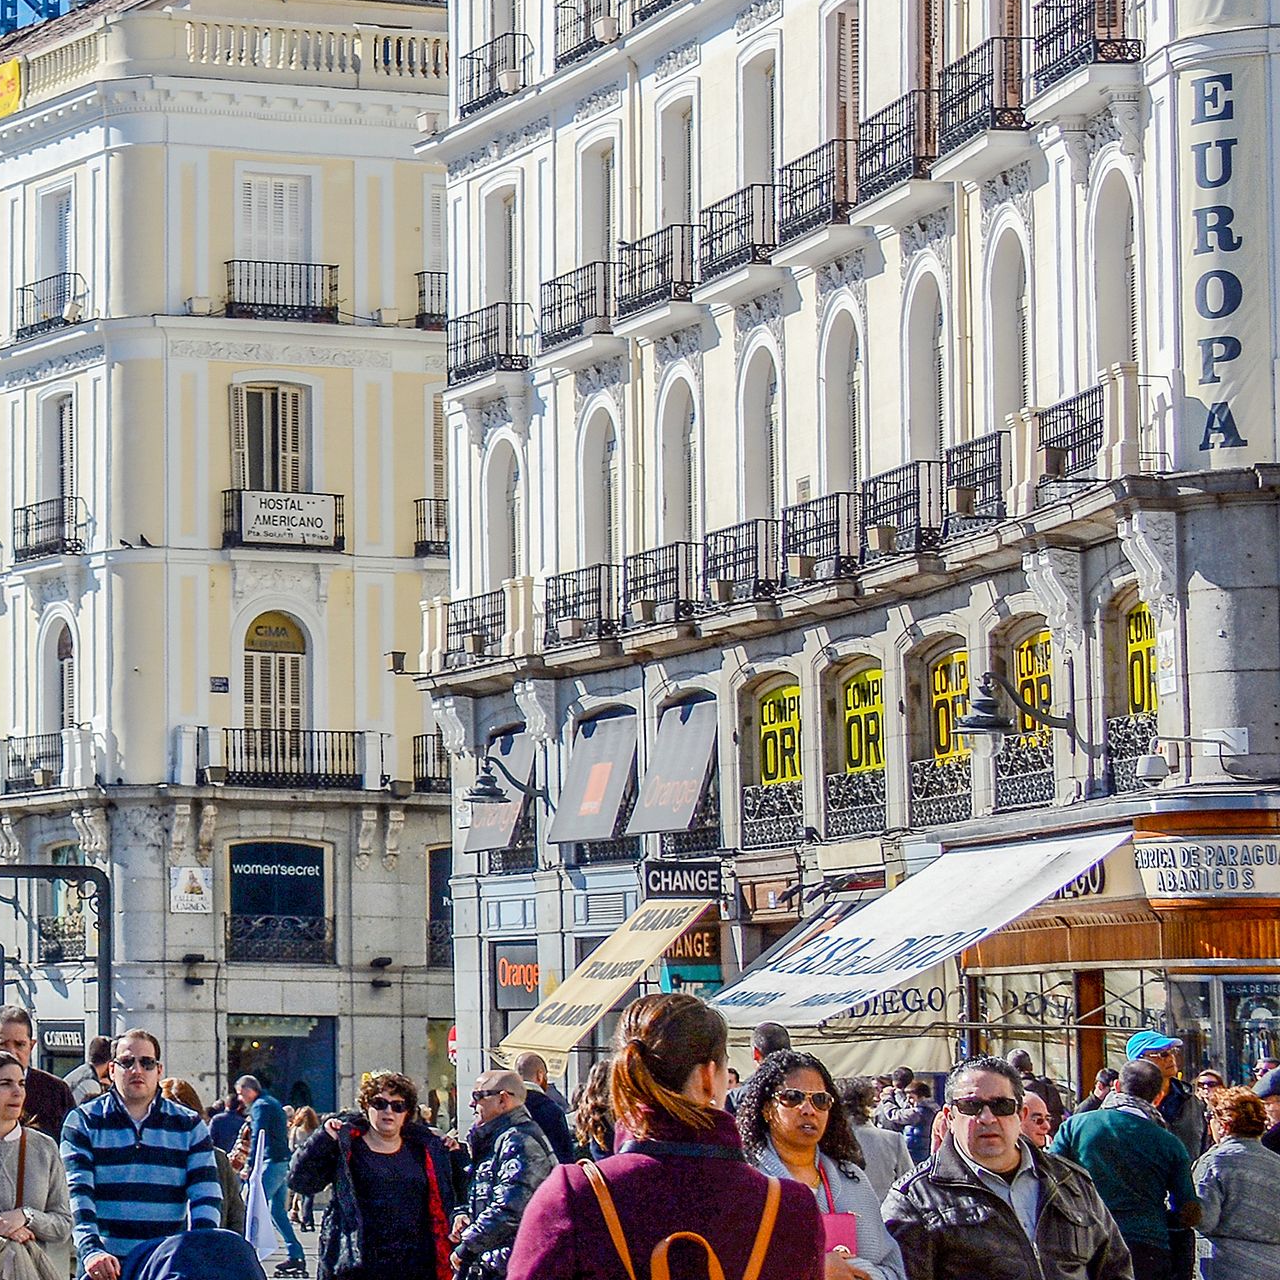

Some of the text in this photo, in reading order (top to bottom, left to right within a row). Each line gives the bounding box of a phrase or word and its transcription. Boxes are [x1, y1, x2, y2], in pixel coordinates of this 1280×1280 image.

[1191, 73, 1248, 453] EUROPA
[259, 497, 304, 512] HOSTAL
[253, 515, 324, 529] AMERICANO
[762, 719, 802, 780] OR
[847, 711, 885, 768] OR
[644, 775, 698, 813] Orange
[1181, 846, 1201, 868] DE
[1205, 844, 1280, 867] PARAGU
[233, 863, 320, 877] women'secret
[648, 869, 719, 892] CHANGE
[1157, 868, 1255, 892] ABANICOS
[628, 906, 698, 932] CHANGE
[770, 935, 876, 976] CASA
[498, 957, 539, 993] Orange
[581, 959, 645, 980] TRANSFER
[534, 1002, 604, 1027] CAMBIO
